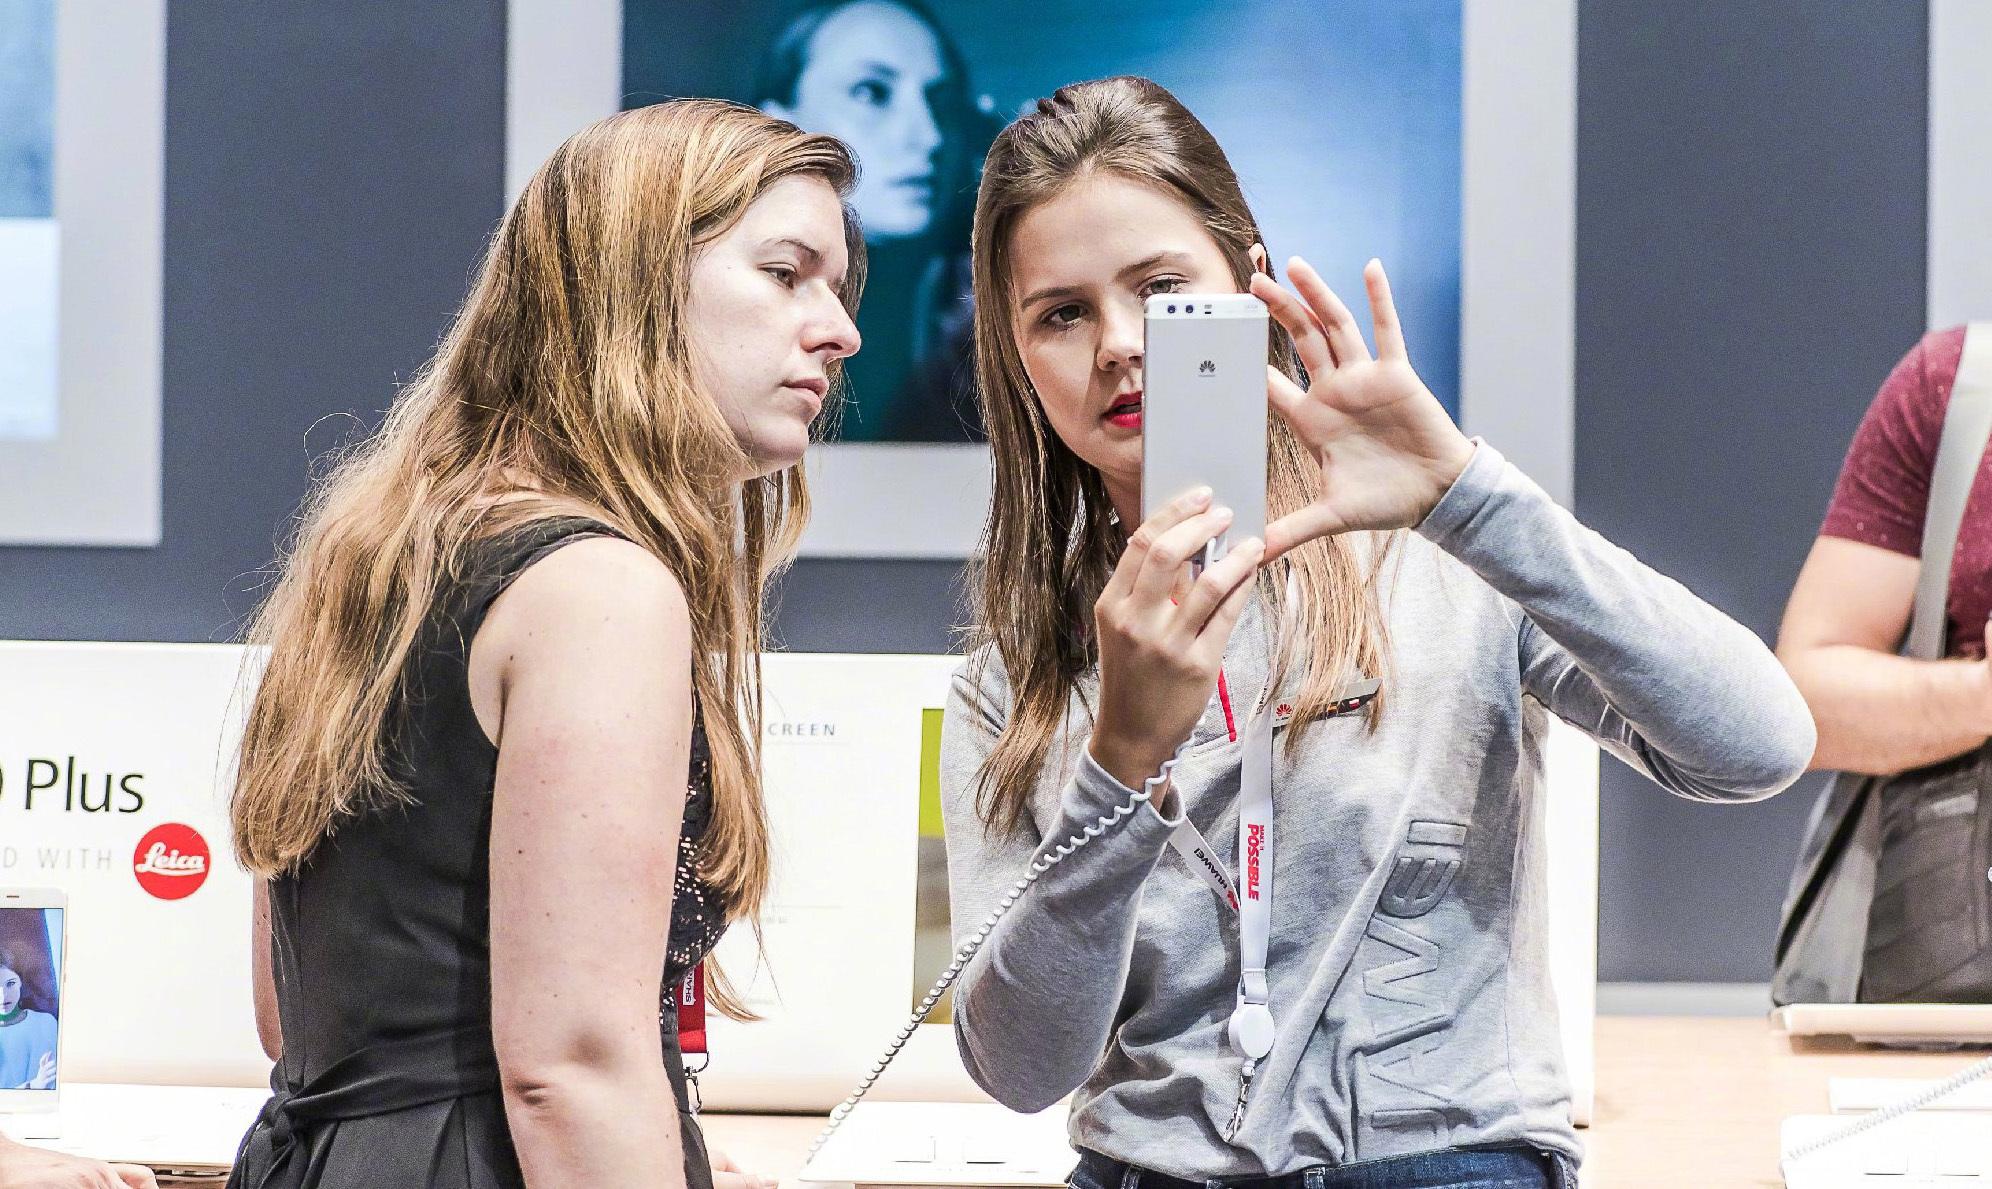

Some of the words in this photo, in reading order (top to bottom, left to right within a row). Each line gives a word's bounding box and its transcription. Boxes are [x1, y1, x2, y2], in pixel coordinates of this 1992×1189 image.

[766, 722, 835, 737] CREEN
[25, 756, 144, 813] Plus
[38, 847, 112, 869] WITH
[135, 842, 206, 877] Leica
[1194, 848, 1227, 889] HUAWEI
[1248, 824, 1259, 901] POSSIBLE
